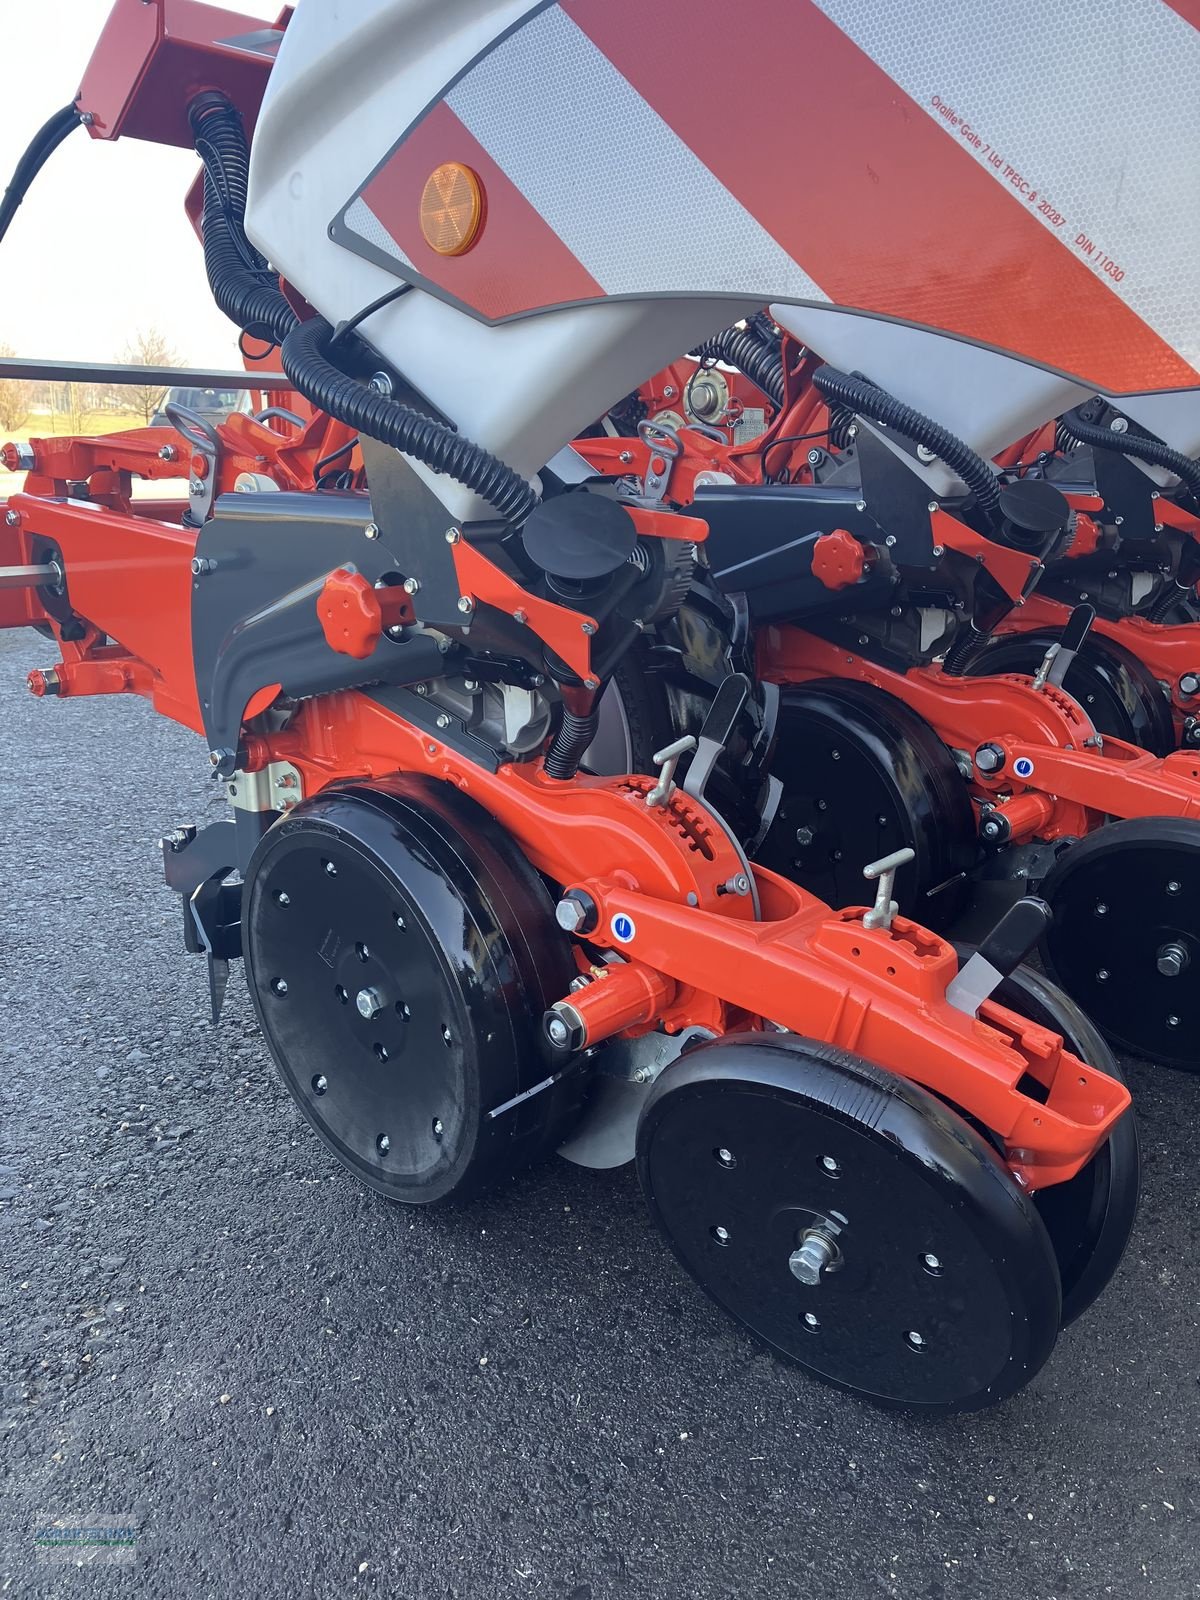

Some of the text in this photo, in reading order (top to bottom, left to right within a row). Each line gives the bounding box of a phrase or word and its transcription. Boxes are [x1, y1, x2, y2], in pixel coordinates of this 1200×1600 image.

[960, 125, 983, 149] Gate
[982, 145, 991, 155] 7
[1002, 164, 1037, 202] TPESC-B
[1037, 200, 1066, 228] 20287
[1074, 233, 1096, 255] DIN
[1094, 251, 1125, 283] 11030
